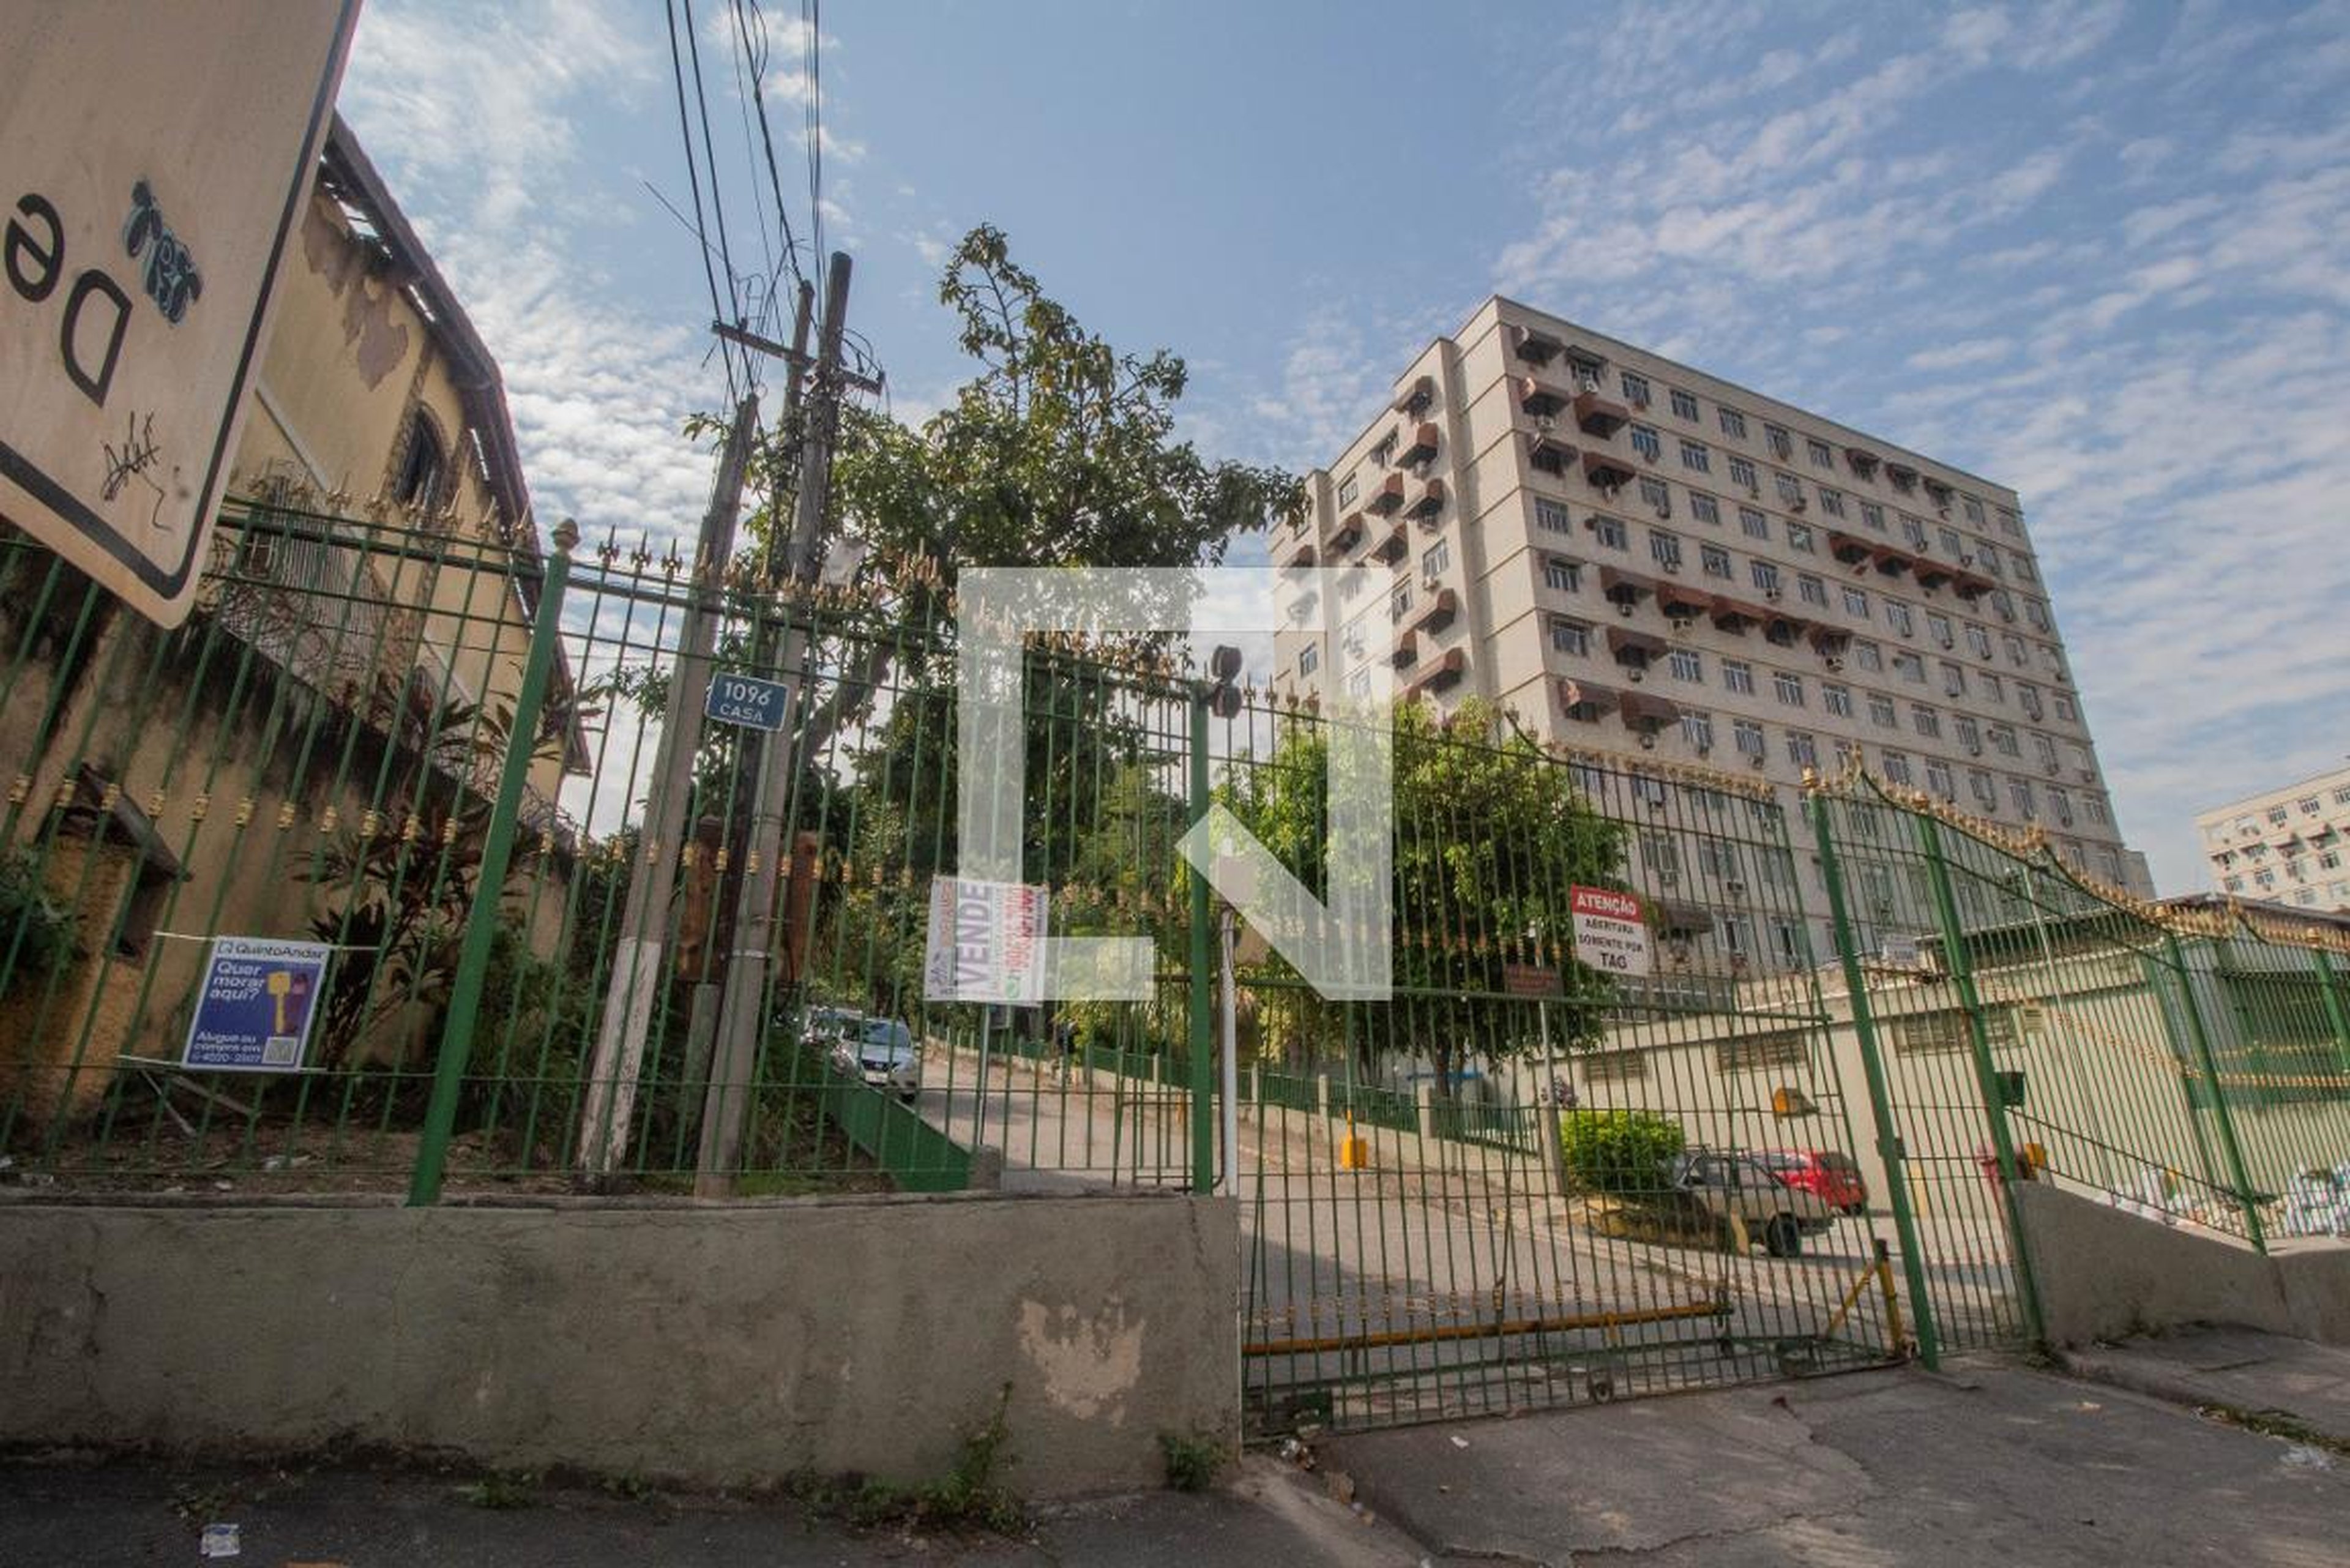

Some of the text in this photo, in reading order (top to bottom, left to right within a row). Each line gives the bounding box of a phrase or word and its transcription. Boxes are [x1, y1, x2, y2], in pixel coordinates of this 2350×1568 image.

[725, 682, 772, 705] 1096
[720, 704, 763, 722] CASA
[1577, 892, 1637, 916] ATENÇÃO
[1586, 918, 1634, 934] ABERTURA
[957, 881, 990, 987] VENDE
[1579, 934, 1623, 949] SOMENTE
[236, 944, 326, 959] QuintoAndar
[1600, 952, 1627, 969] TAG
[217, 961, 262, 976] Quer
[214, 976, 264, 987] morar
[209, 987, 260, 1002] aqui?
[196, 1031, 256, 1043] Alugue ou
